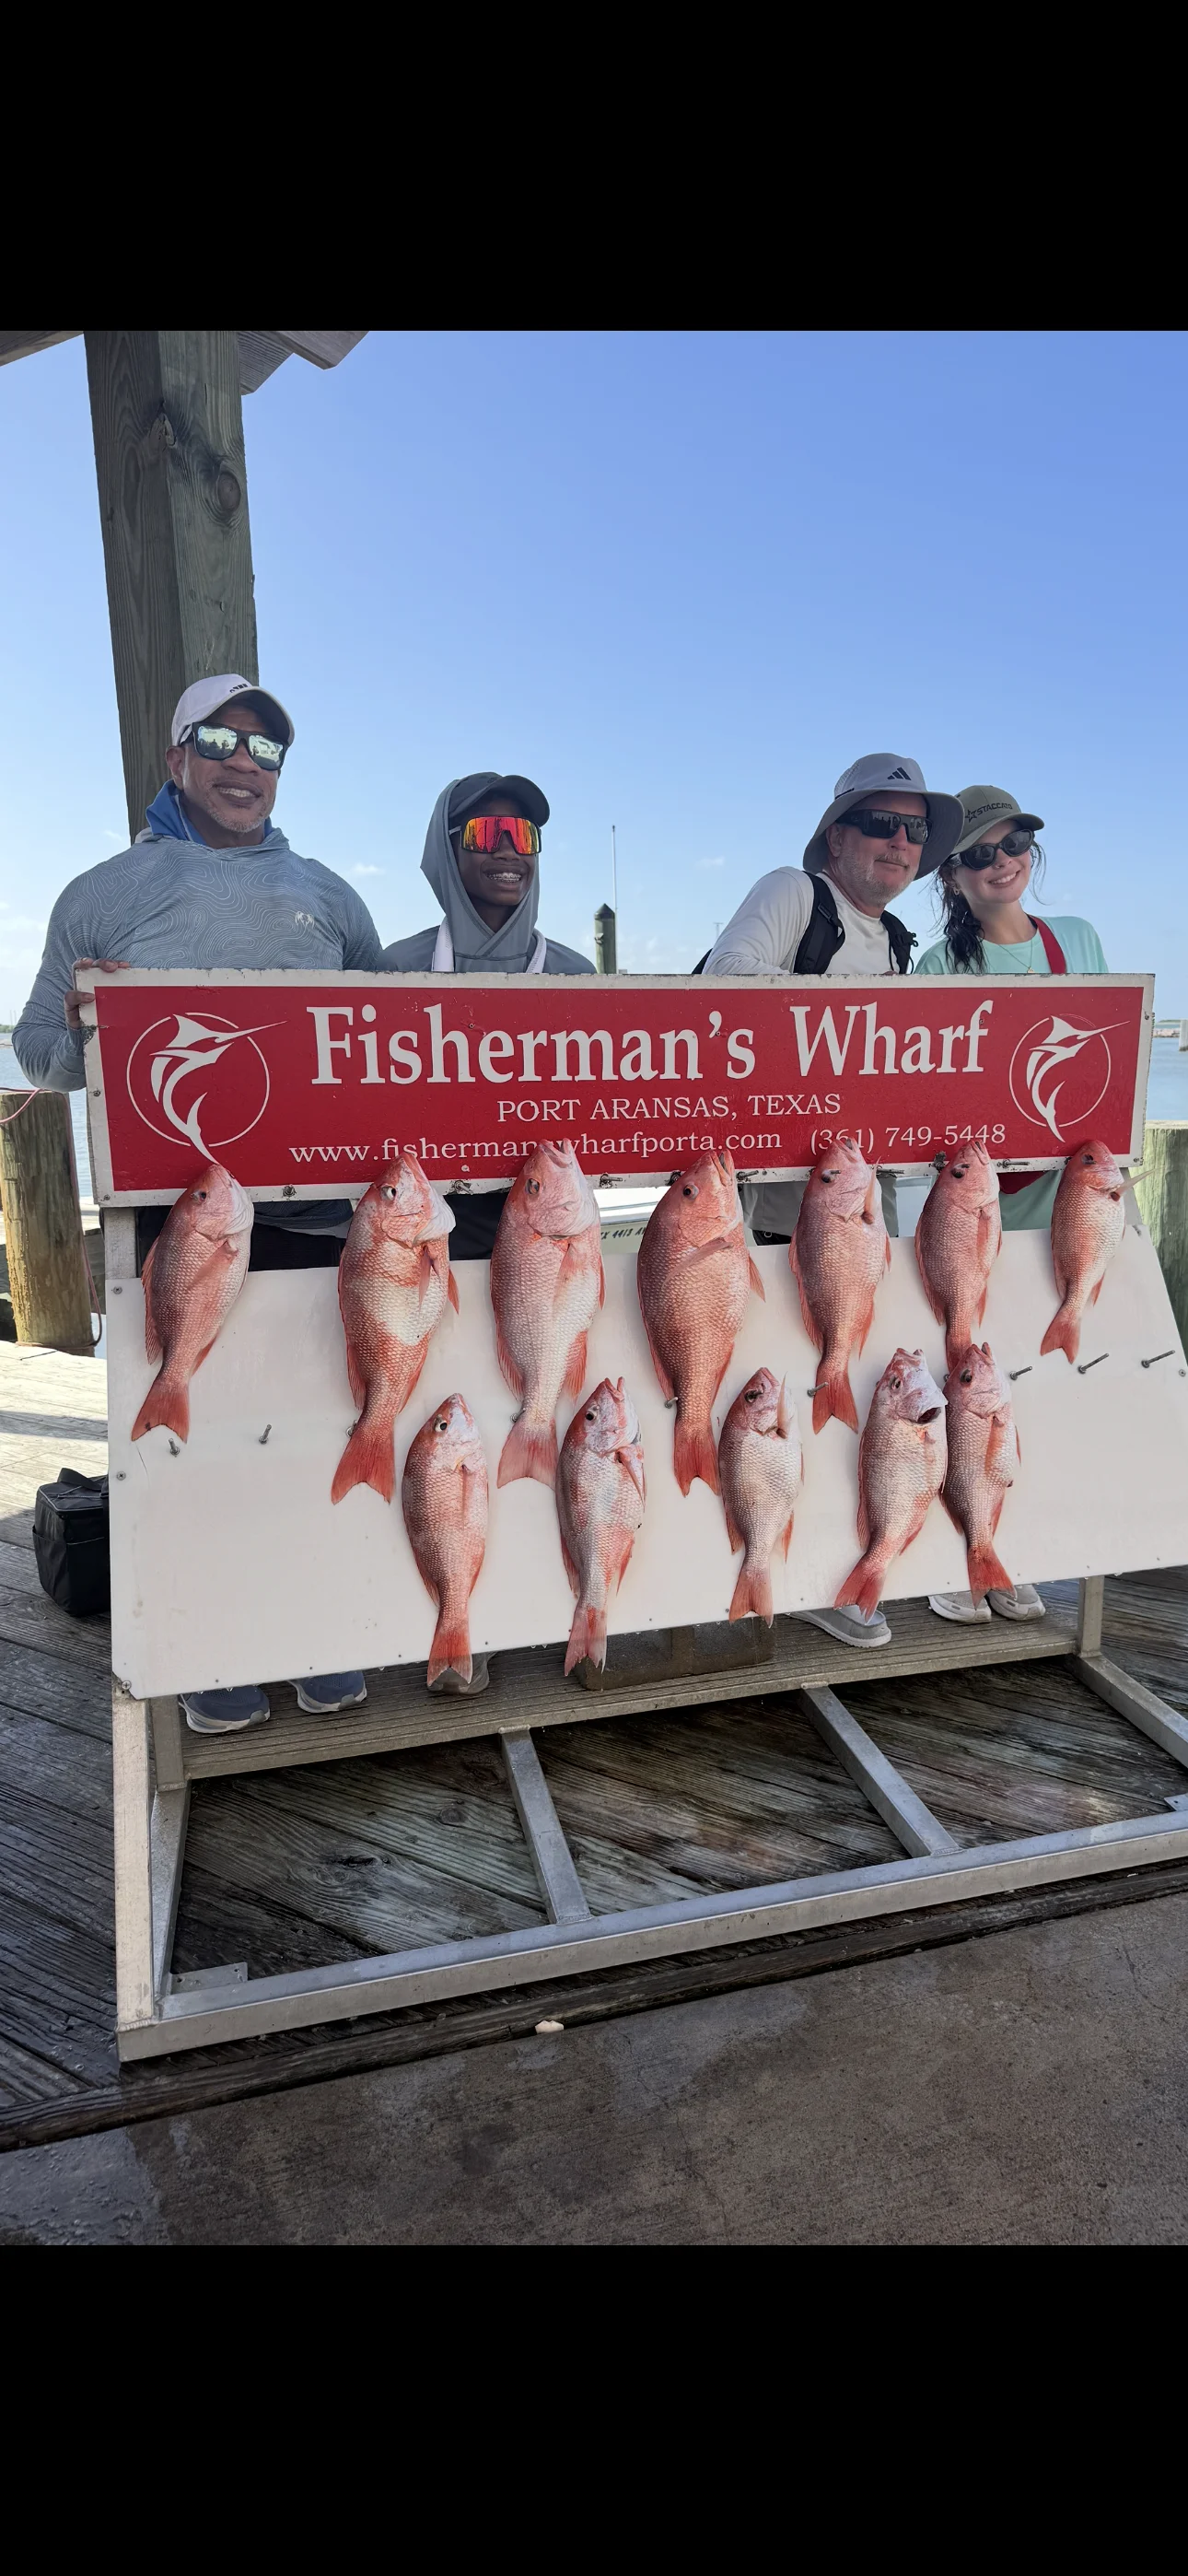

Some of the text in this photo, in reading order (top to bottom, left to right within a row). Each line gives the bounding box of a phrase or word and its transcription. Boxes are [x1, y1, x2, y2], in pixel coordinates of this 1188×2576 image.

[976, 802, 1012, 815] STACCATO
[306, 1000, 994, 1085] Fisherman's Wharf
[497, 1093, 841, 1122] PORT ARANSAS, TEXAS
[289, 1131, 782, 1162] www.fishermanharfporta.com
[885, 1123, 1006, 1147] 749-5448
